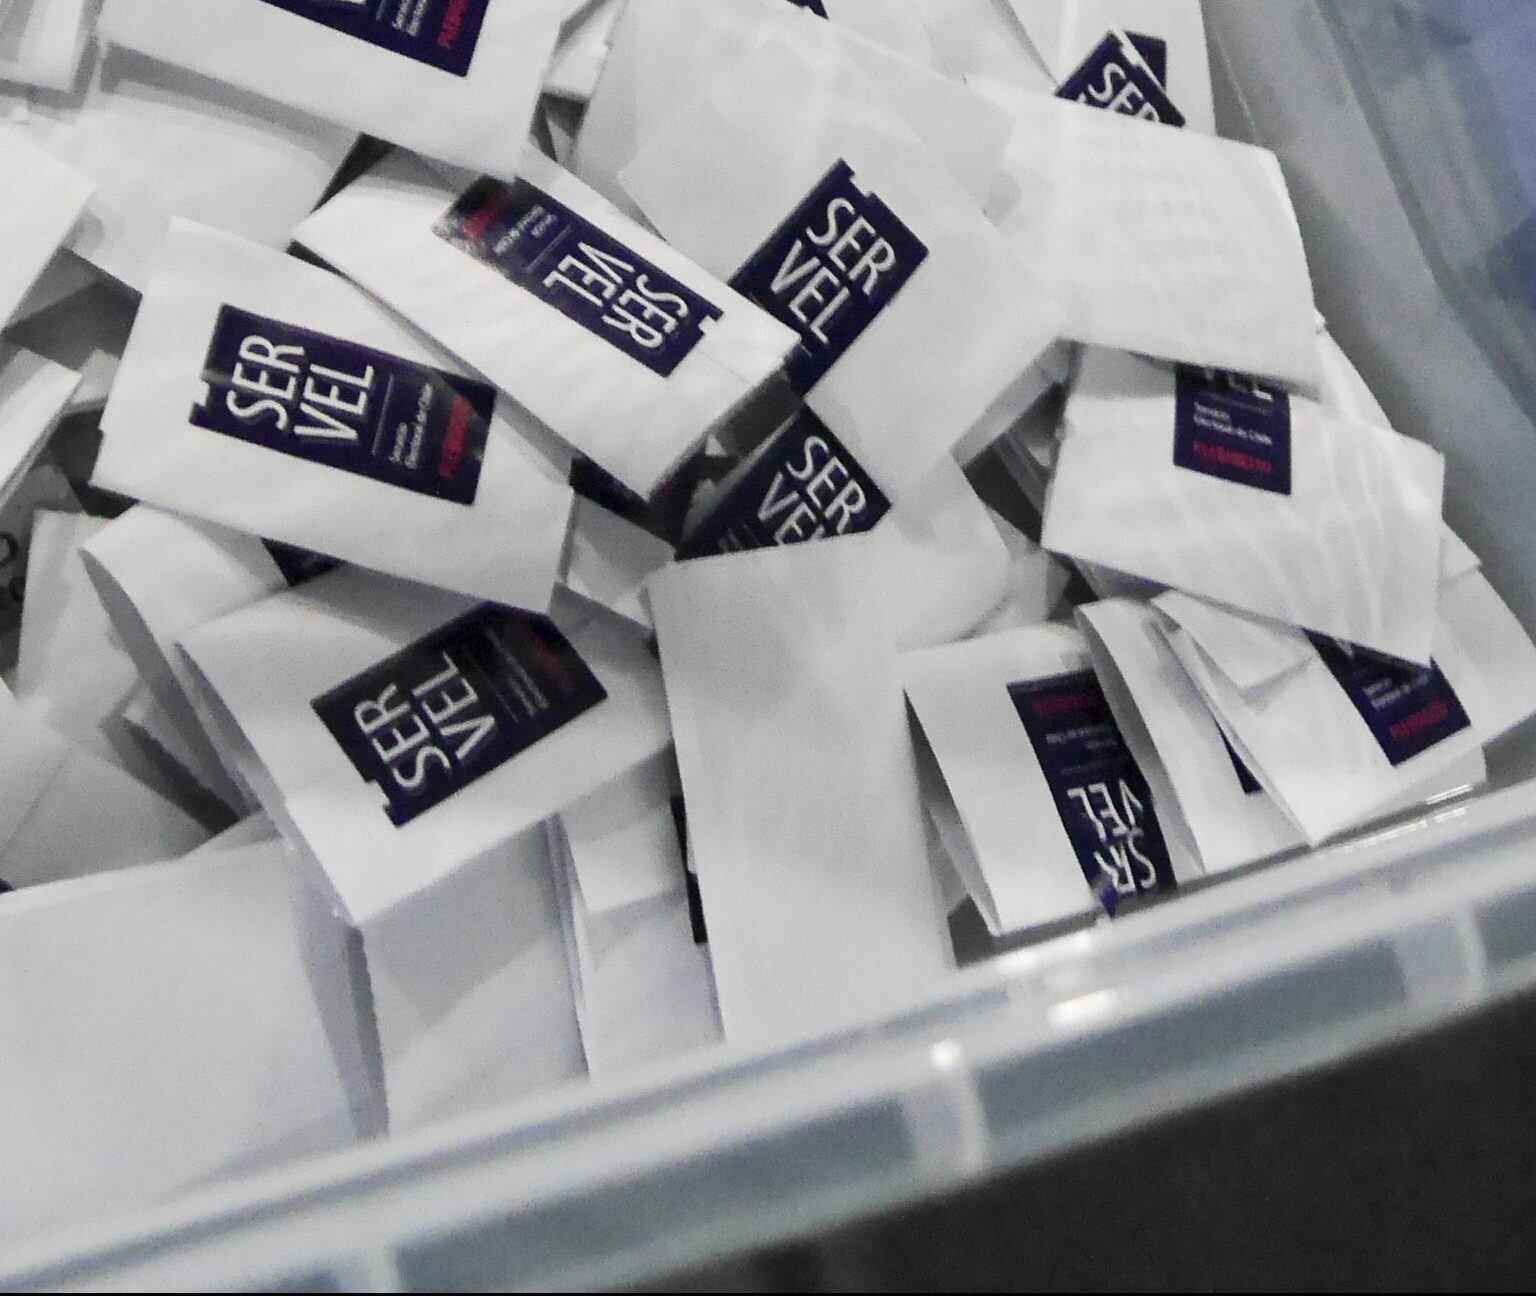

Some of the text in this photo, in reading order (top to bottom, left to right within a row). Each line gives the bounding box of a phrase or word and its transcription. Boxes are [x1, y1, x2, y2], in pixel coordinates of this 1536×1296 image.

[542, 241, 635, 308] VEL
[770, 239, 850, 344] VEL
[805, 197, 896, 296] SER
[601, 273, 689, 348] SER
[226, 334, 305, 430] SER
[293, 363, 375, 440] VEL
[757, 471, 825, 544] VE
[786, 435, 867, 535] SER
[354, 683, 451, 788] SER
[411, 653, 496, 760] VEL
[1066, 779, 1143, 842] VEL
